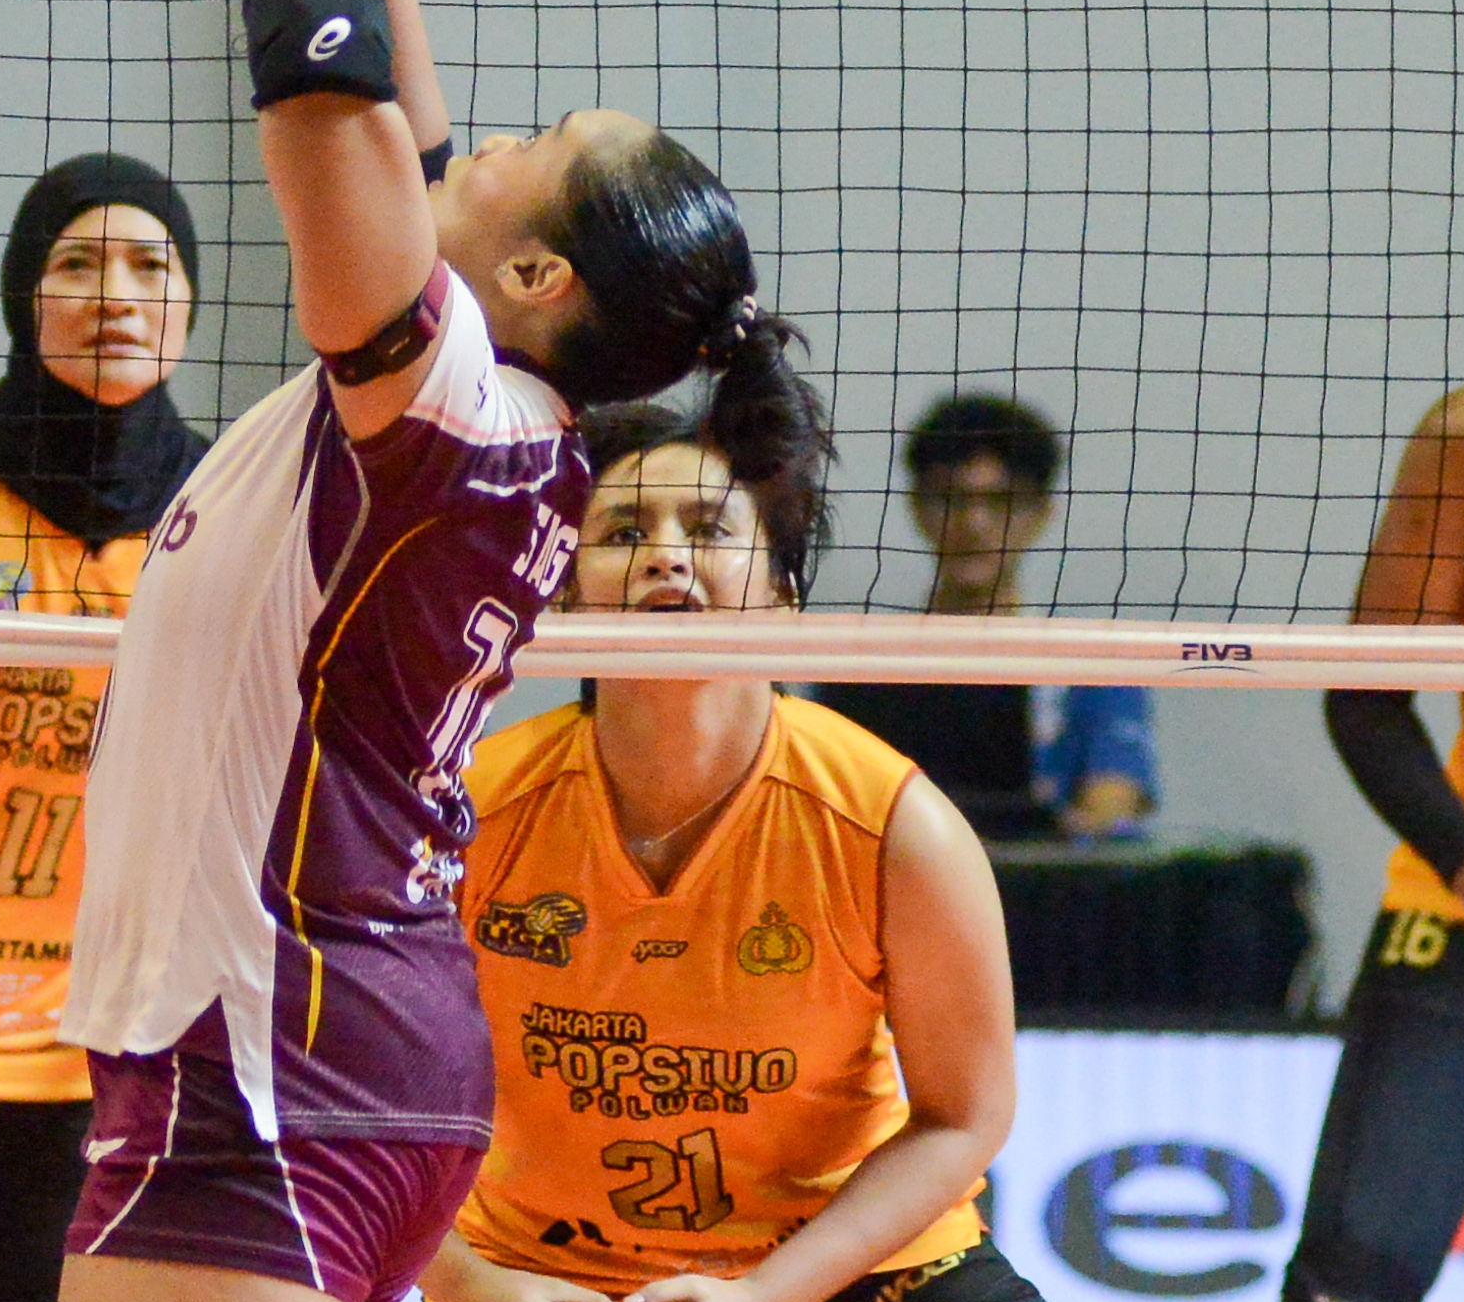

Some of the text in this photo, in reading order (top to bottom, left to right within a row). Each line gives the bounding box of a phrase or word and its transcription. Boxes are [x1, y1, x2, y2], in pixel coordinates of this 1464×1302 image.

[1181, 642, 1253, 661] FIVB
[521, 1002, 647, 1043] JAKARTA
[521, 1032, 798, 1097] POPSIVO
[570, 1090, 750, 1121] POLWAN
[600, 1126, 736, 1234] 21
